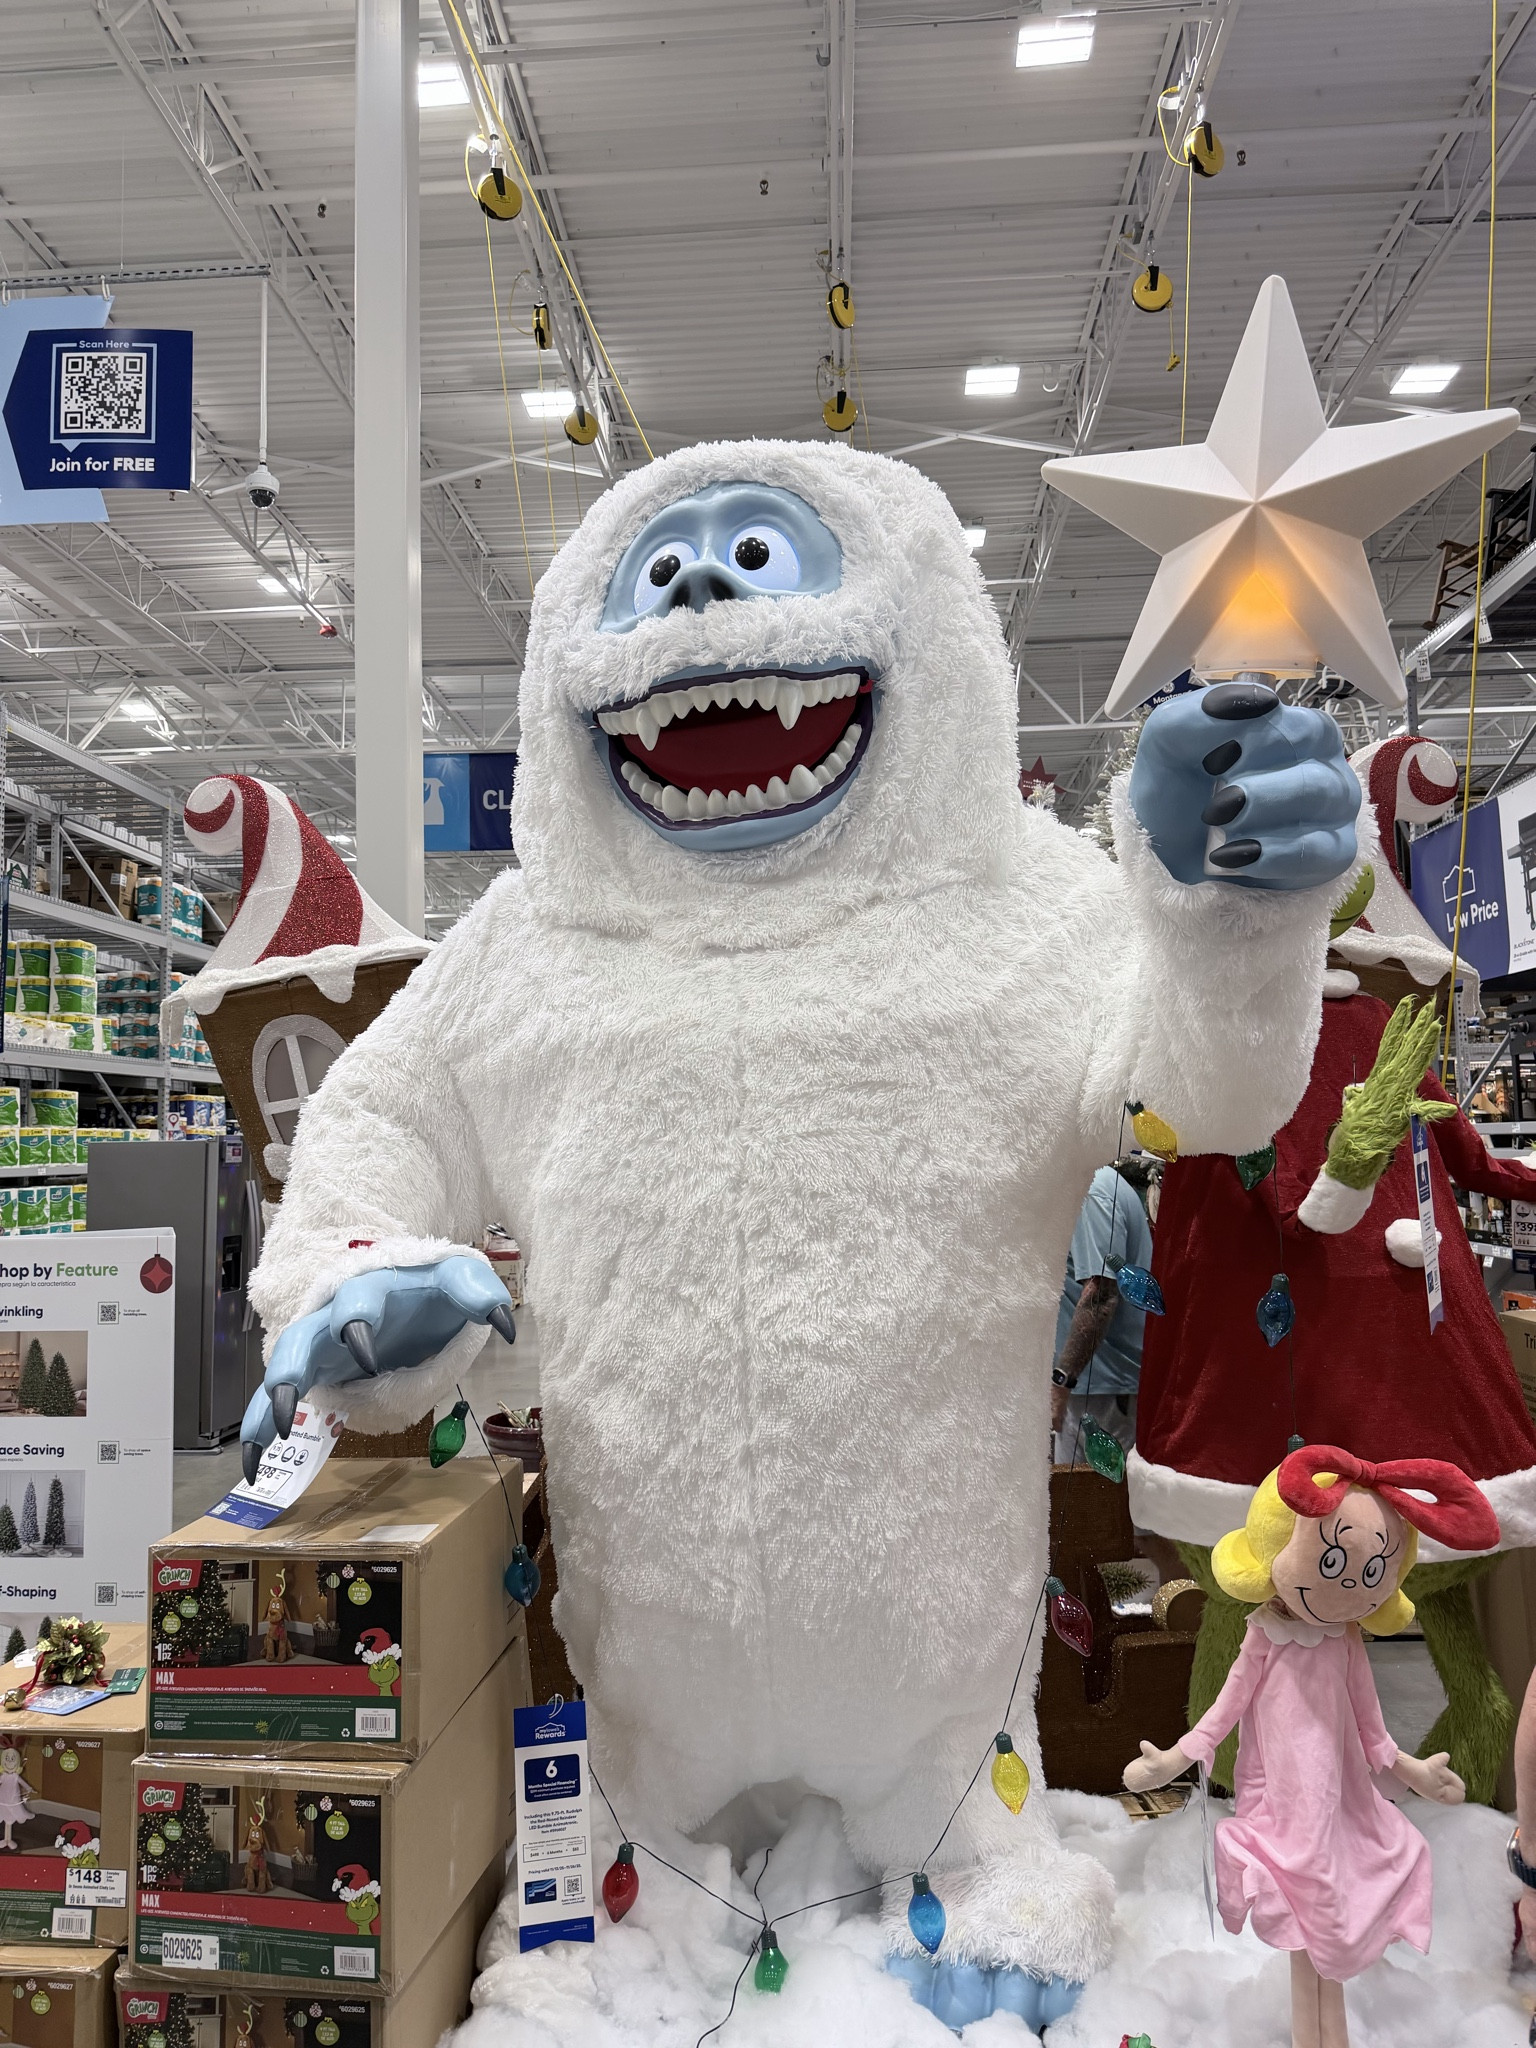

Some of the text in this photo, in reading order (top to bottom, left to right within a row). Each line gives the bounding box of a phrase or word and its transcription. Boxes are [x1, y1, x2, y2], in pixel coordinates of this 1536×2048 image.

[79, 340, 130, 349] Scan Here
[50, 457, 155, 472] Join for FREE
[1470, 899, 1499, 925] Price
[0, 1262, 118, 1280] hop by Feature
[0, 1444, 65, 1458] ace Saving
[158, 1568, 192, 1585] GRINCH
[155, 1643, 172, 1661] 1 pc
[162, 1652, 171, 1662] pz
[156, 1672, 174, 1685] MAX
[535, 1730, 566, 1740] Rewards
[546, 1760, 558, 1778] 6
[143, 1789, 176, 1806] GRINCH
[69, 1869, 101, 1883] $148
[140, 1865, 158, 1883] 1 pc
[147, 1874, 156, 1883] pz
[141, 1894, 160, 1908] MAX
[164, 1936, 202, 1961] 6029625
[127, 2001, 159, 2018] GRINCH
